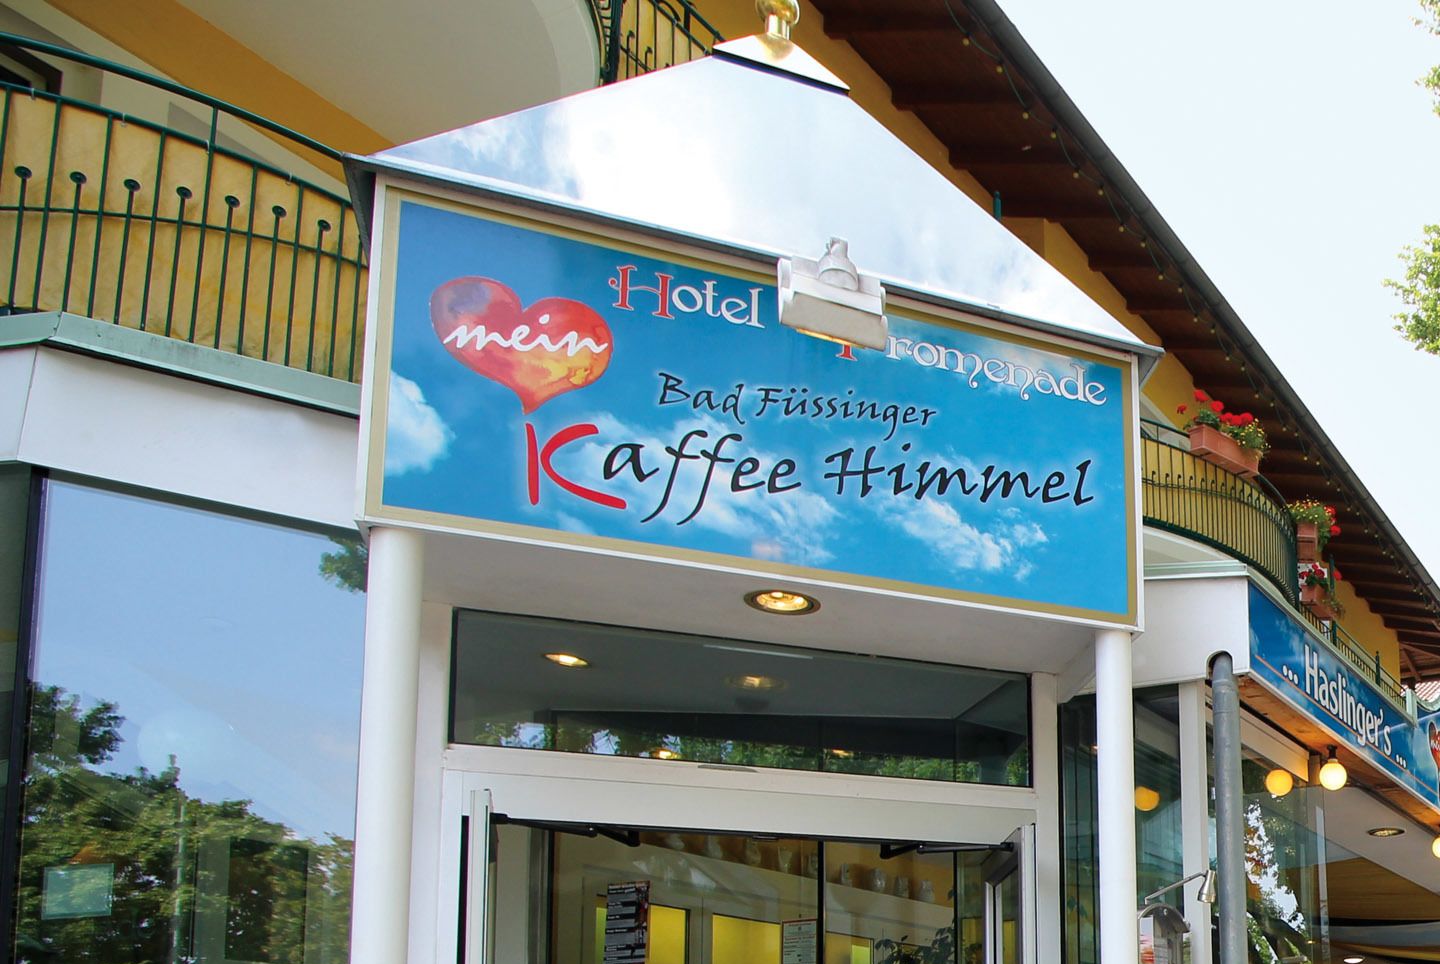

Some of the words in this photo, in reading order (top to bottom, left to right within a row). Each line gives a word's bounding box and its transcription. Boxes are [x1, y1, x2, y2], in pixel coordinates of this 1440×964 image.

[443, 313, 609, 356] mein
[609, 265, 766, 330] Hotel
[836, 333, 1107, 405] romenade
[657, 372, 744, 425] Bad
[755, 386, 937, 441] Füssinger
[524, 422, 802, 525] Kaffee
[824, 443, 1094, 506] Himmel
[1304, 643, 1392, 757] Haslinger's
